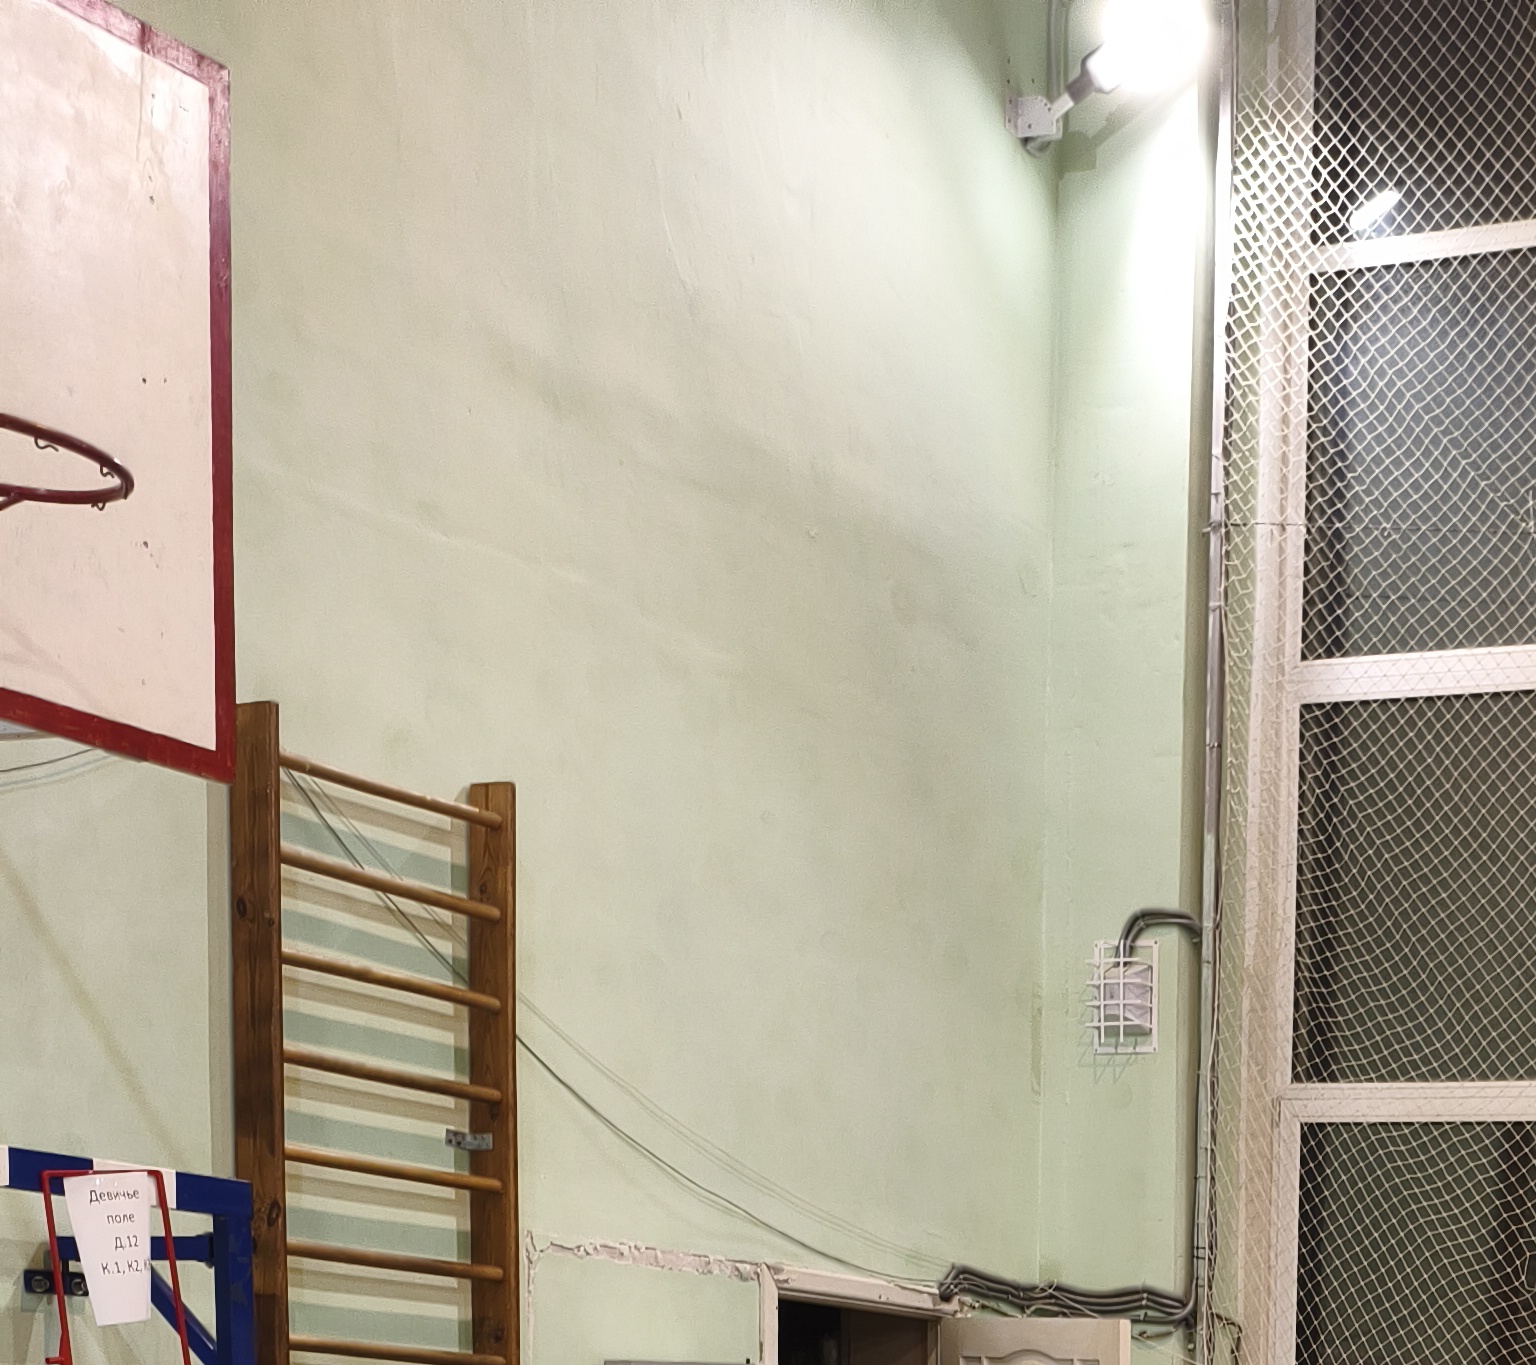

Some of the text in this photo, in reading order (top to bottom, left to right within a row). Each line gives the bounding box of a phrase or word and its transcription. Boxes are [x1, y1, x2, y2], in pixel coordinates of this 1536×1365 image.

[89, 1189, 140, 1206] Девичье
[106, 1213, 136, 1225] поле
[114, 1235, 139, 1251] Д.12
